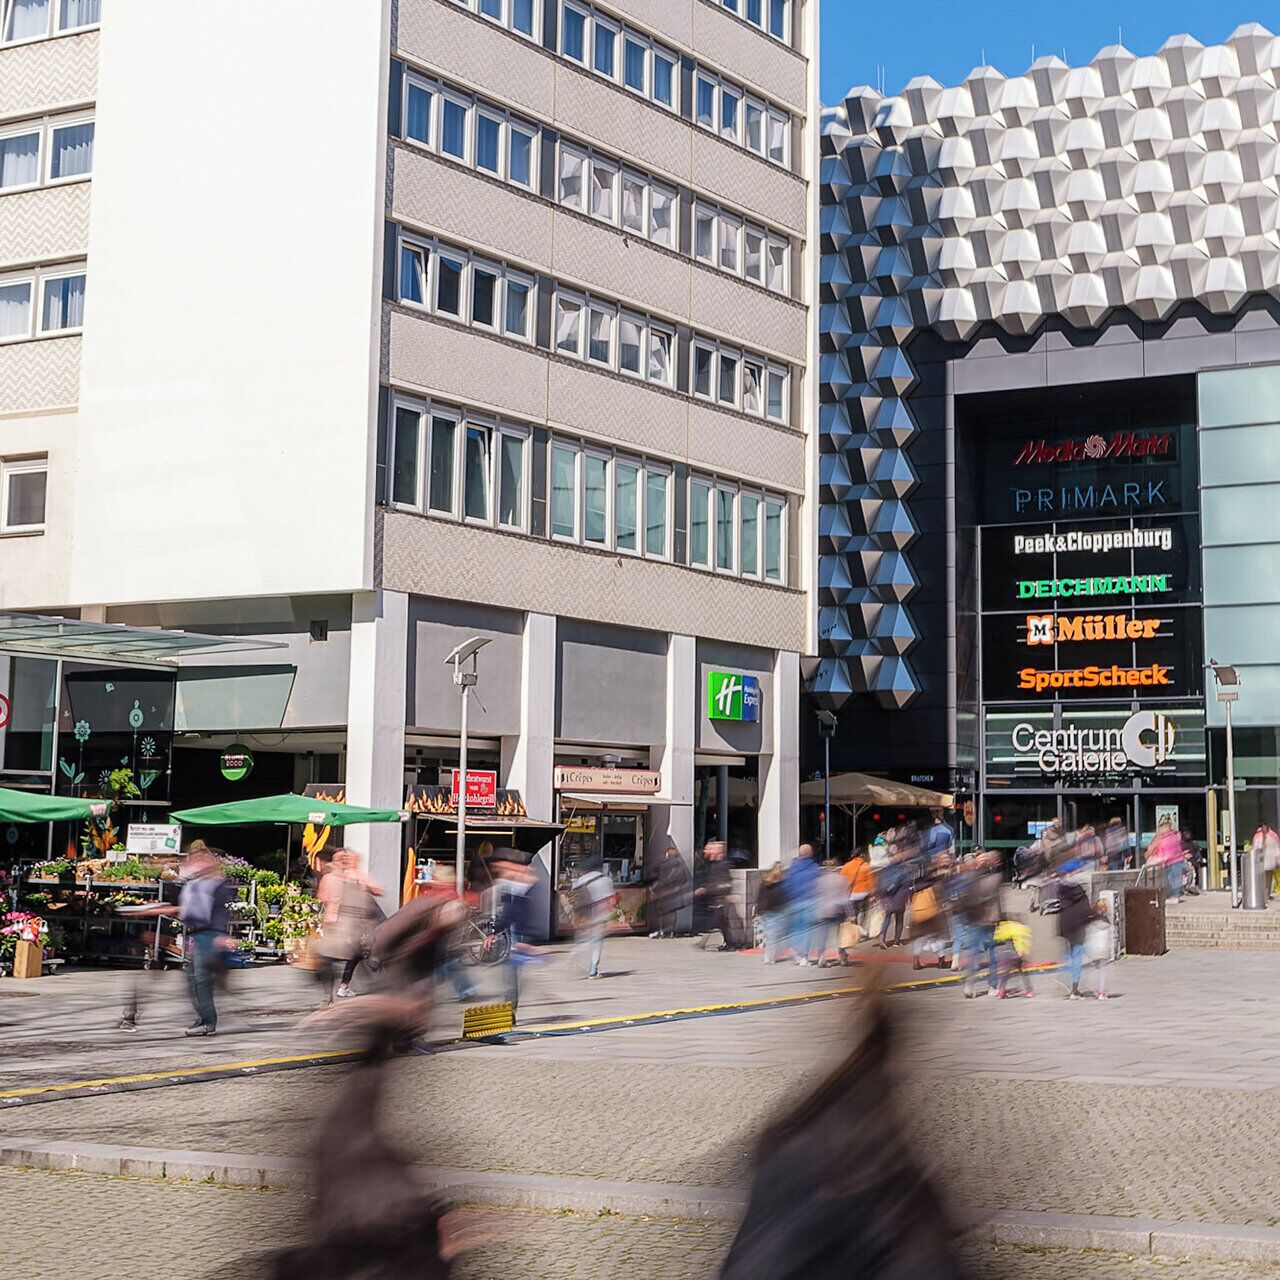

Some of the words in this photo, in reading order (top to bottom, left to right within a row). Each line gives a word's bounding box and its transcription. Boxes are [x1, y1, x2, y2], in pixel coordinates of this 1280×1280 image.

[1015, 480, 1166, 513] PRIMARK
[1019, 574, 1167, 598] DEICHMANN
[1057, 614, 1160, 641] Müller
[1020, 663, 1169, 692] SportScheck
[1012, 723, 1122, 752] Centrum
